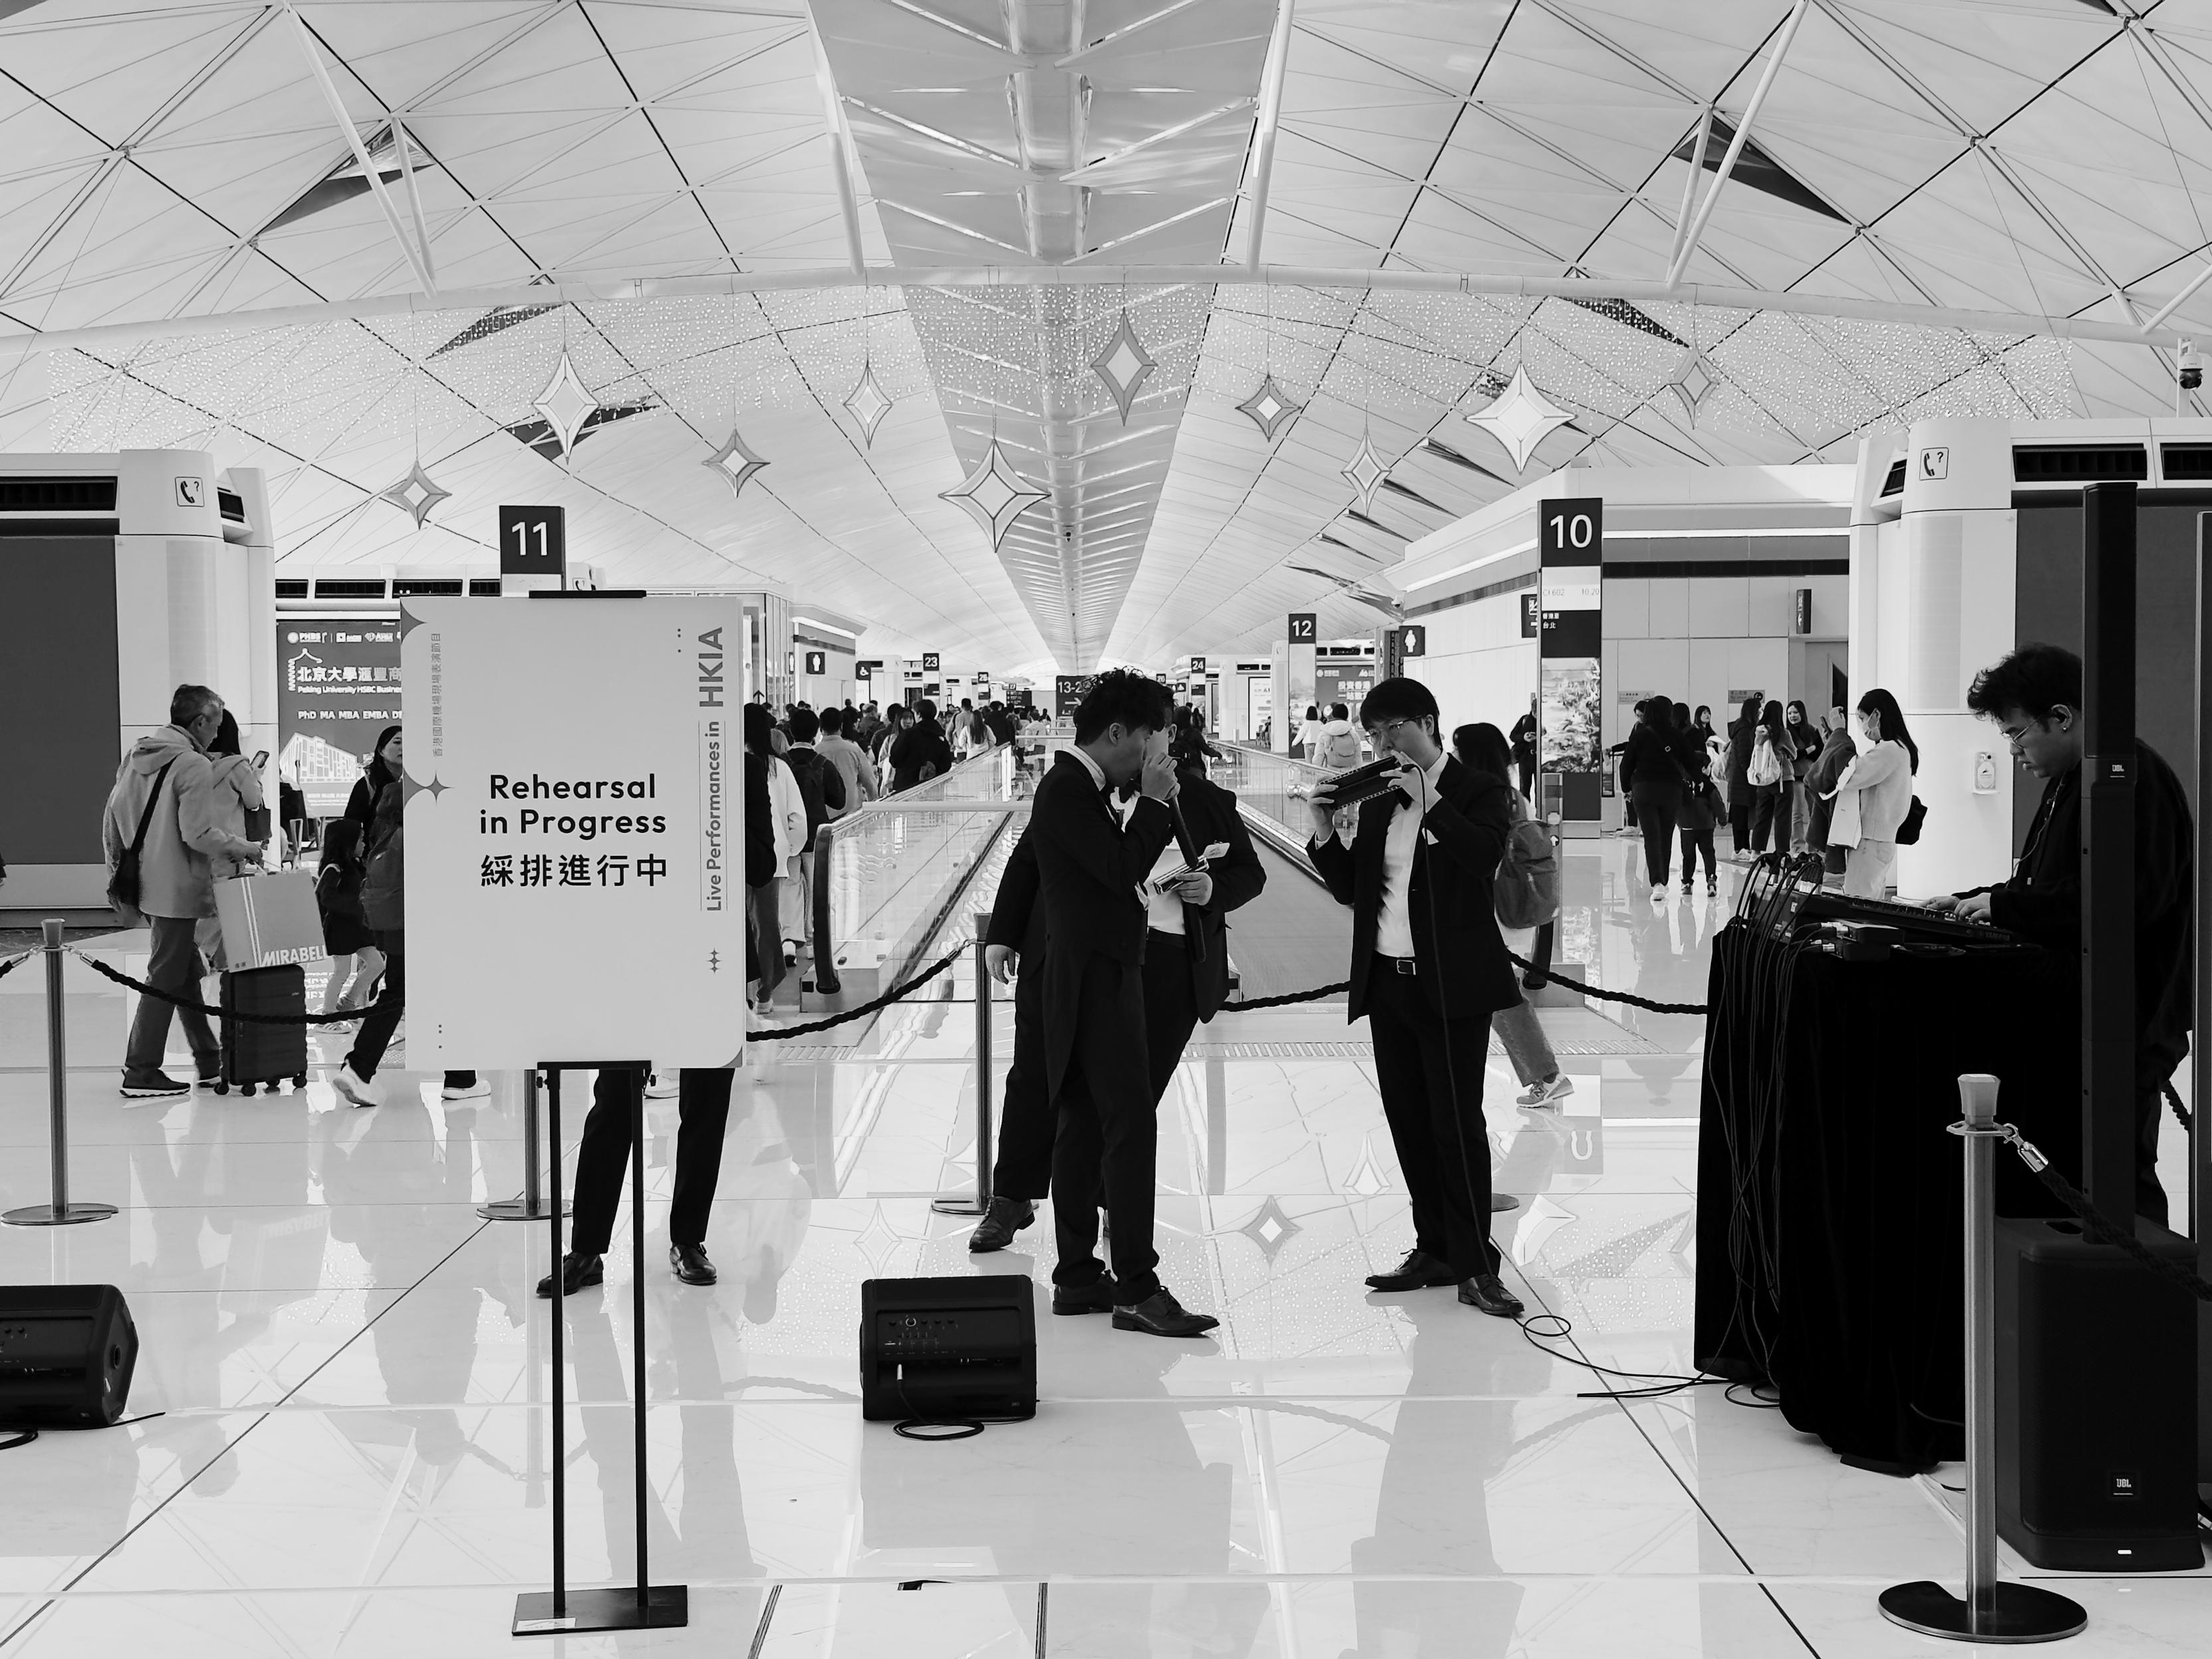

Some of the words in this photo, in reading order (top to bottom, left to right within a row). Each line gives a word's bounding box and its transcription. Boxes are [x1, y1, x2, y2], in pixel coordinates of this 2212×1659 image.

[511, 522, 547, 555] 11
[1550, 514, 1593, 549] 10
[1292, 620, 1312, 637] 12
[698, 627, 723, 707] HKIA
[924, 657, 938, 667] 23
[1192, 661, 1204, 671] 24
[298, 686, 322, 694] Peking
[323, 686, 356, 694] University
[299, 710, 317, 720] PhD
[320, 710, 335, 720] MA
[339, 710, 360, 720] MBA
[362, 710, 388, 720] EMBA
[705, 721, 719, 737] in
[490, 773, 656, 799] Rehearsal
[706, 742, 721, 870] Performances
[480, 809, 507, 833] in
[520, 810, 666, 840] Progress
[480, 853, 666, 887] 綵排進行中
[706, 873, 722, 911] Live
[2116, 1478, 2132, 1488] JBL
